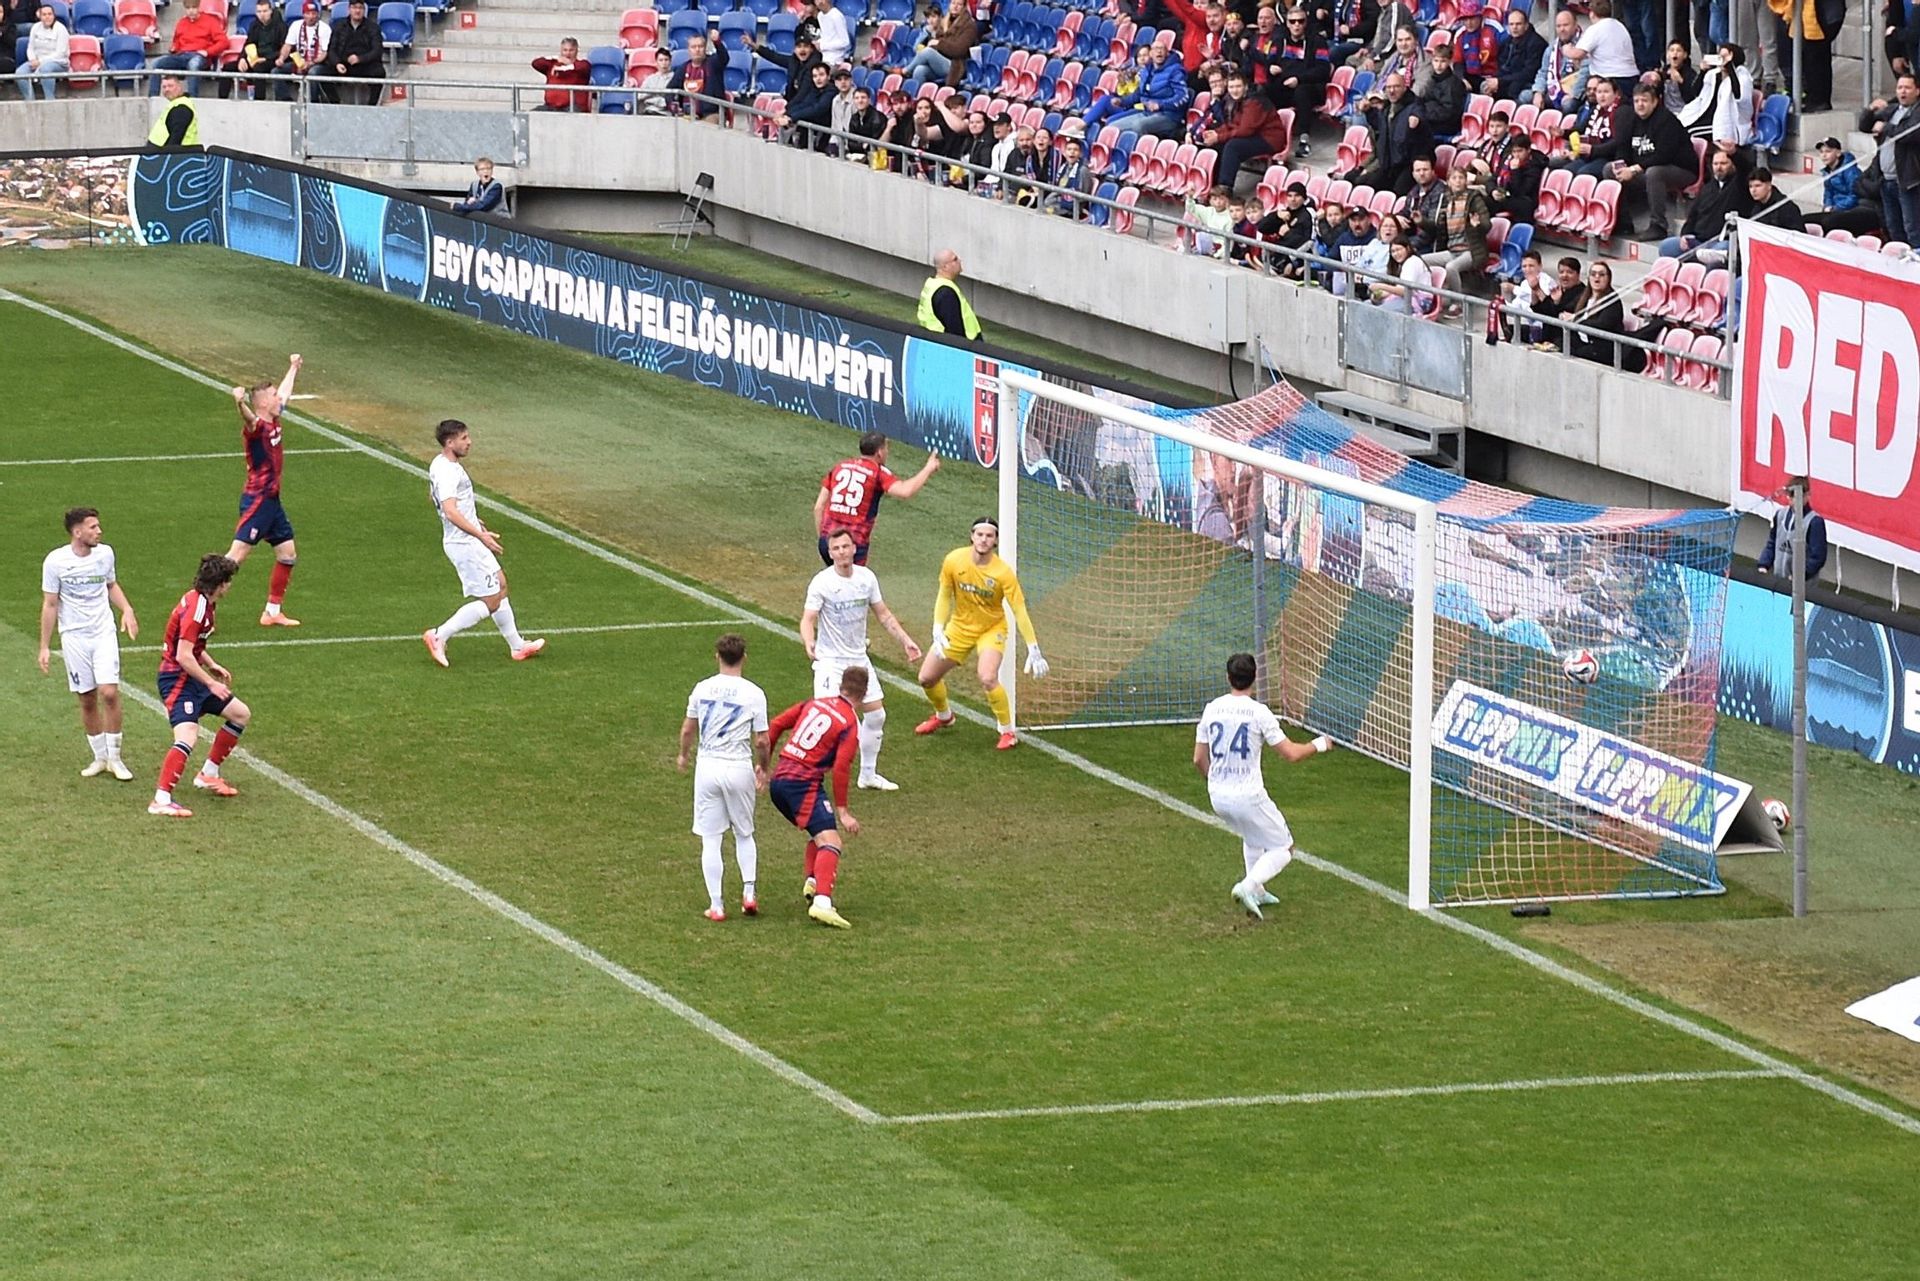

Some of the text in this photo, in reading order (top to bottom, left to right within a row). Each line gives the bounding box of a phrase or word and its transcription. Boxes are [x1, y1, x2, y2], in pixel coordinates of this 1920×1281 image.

[433, 234, 893, 406] EGY CSAPATBAN A FELELŐS HOLNAPÉRT!
[1755, 272, 1920, 499] RED
[831, 468, 868, 508] 25
[823, 677, 830, 689] 4
[700, 699, 744, 738] 77
[791, 705, 832, 751] 18
[1209, 721, 1251, 760] 24
